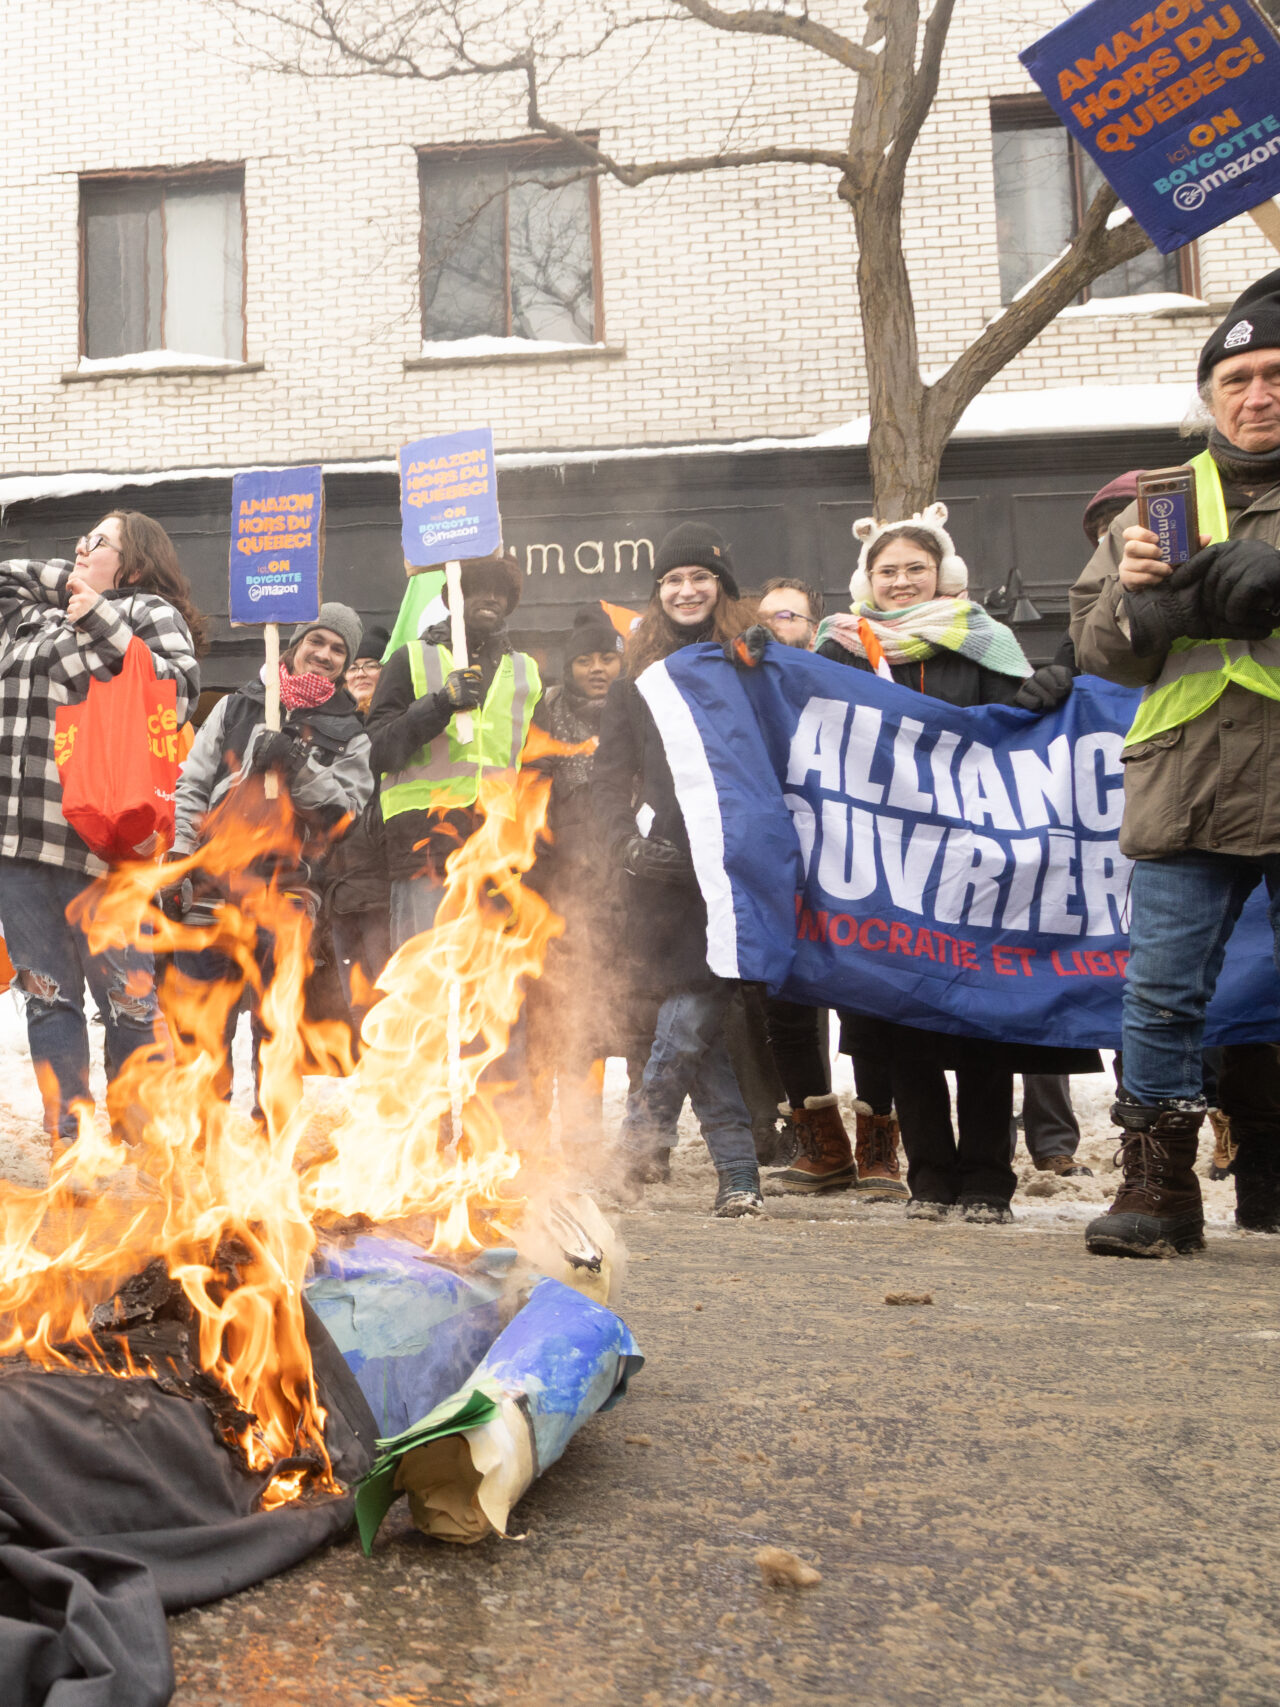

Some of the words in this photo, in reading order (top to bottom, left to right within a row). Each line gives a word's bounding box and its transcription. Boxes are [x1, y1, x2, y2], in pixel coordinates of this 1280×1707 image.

[1071, 48, 1180, 128] HORS
[1174, 4, 1241, 62] DU
[1096, 37, 1265, 152] QUÉBEC!
[1189, 107, 1242, 147] ON
[1153, 114, 1280, 194] BOYCOTTE
[1226, 336, 1248, 347] CSN
[406, 448, 487, 476] AMAZON
[407, 470, 459, 490] HORS
[460, 464, 488, 480] DU
[240, 493, 314, 515] AMAZON
[407, 480, 489, 508] QUÉBEC!
[238, 515, 287, 534] HORS
[287, 514, 311, 532] DU
[443, 506, 467, 518] ON
[418, 516, 480, 534] BOYCOTTE
[237, 532, 312, 556] QUÉBEC!
[246, 572, 302, 585] BOYCOTTE
[268, 560, 290, 573] ON
[991, 945, 1037, 977] ET
